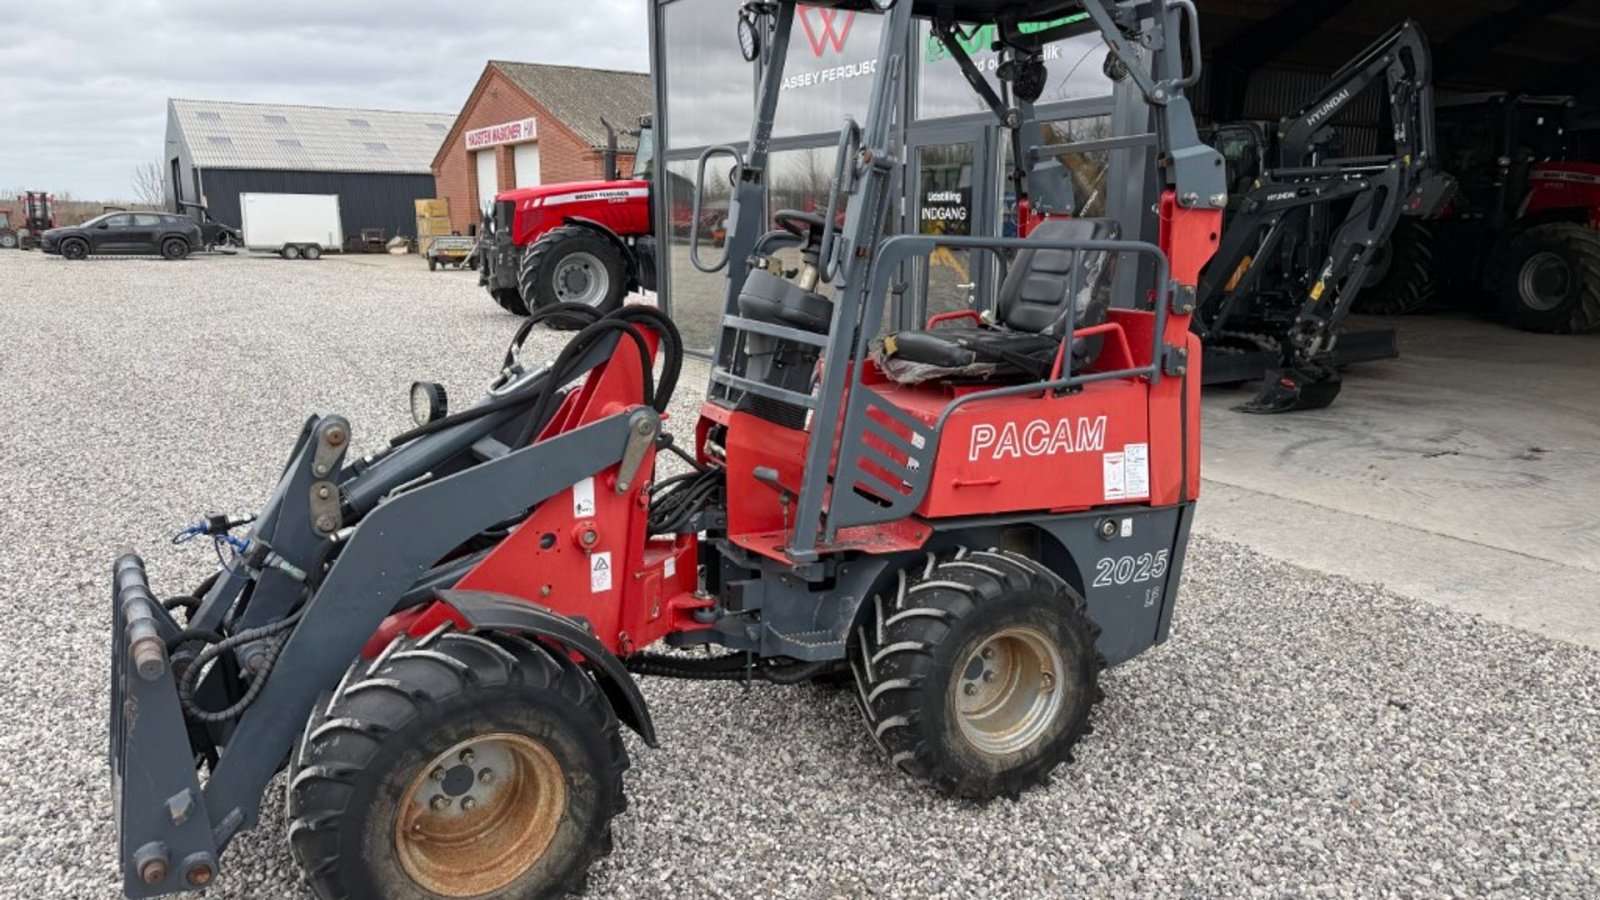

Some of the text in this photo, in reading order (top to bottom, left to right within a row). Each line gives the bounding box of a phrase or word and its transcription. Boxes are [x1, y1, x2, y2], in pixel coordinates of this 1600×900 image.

[781, 70, 820, 91] ASSEY
[1306, 88, 1350, 126] HYUNDAI
[921, 206, 967, 221] INDGANG
[968, 415, 1108, 462] PACAM
[1092, 548, 1169, 588] 2025
